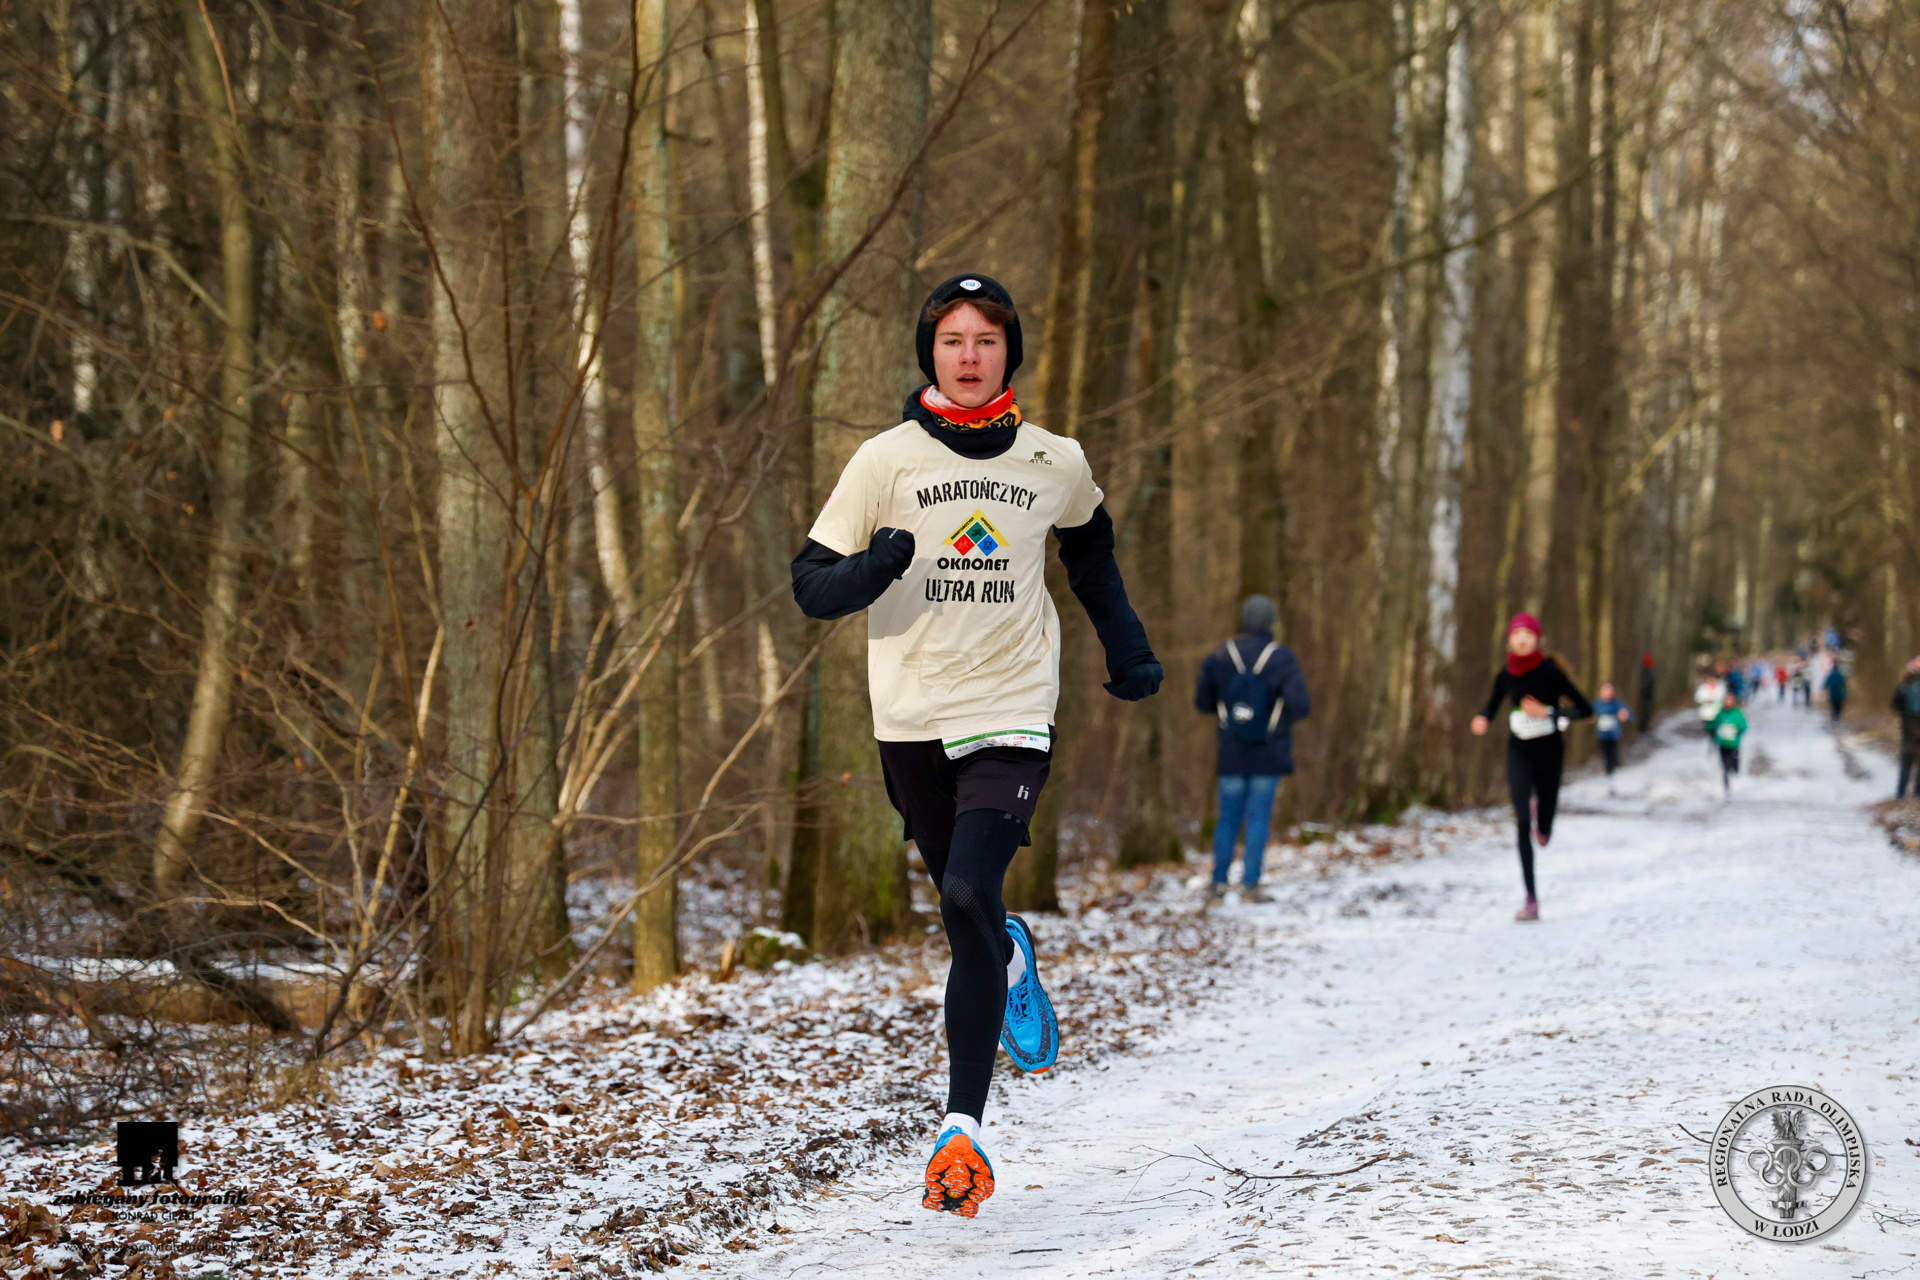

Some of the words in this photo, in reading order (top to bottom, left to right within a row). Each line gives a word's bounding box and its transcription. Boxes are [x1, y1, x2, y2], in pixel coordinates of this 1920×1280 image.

[916, 477, 1037, 511] MARATOŃCZYCY
[926, 579, 975, 602] ULTRA
[981, 580, 1015, 603] RUN
